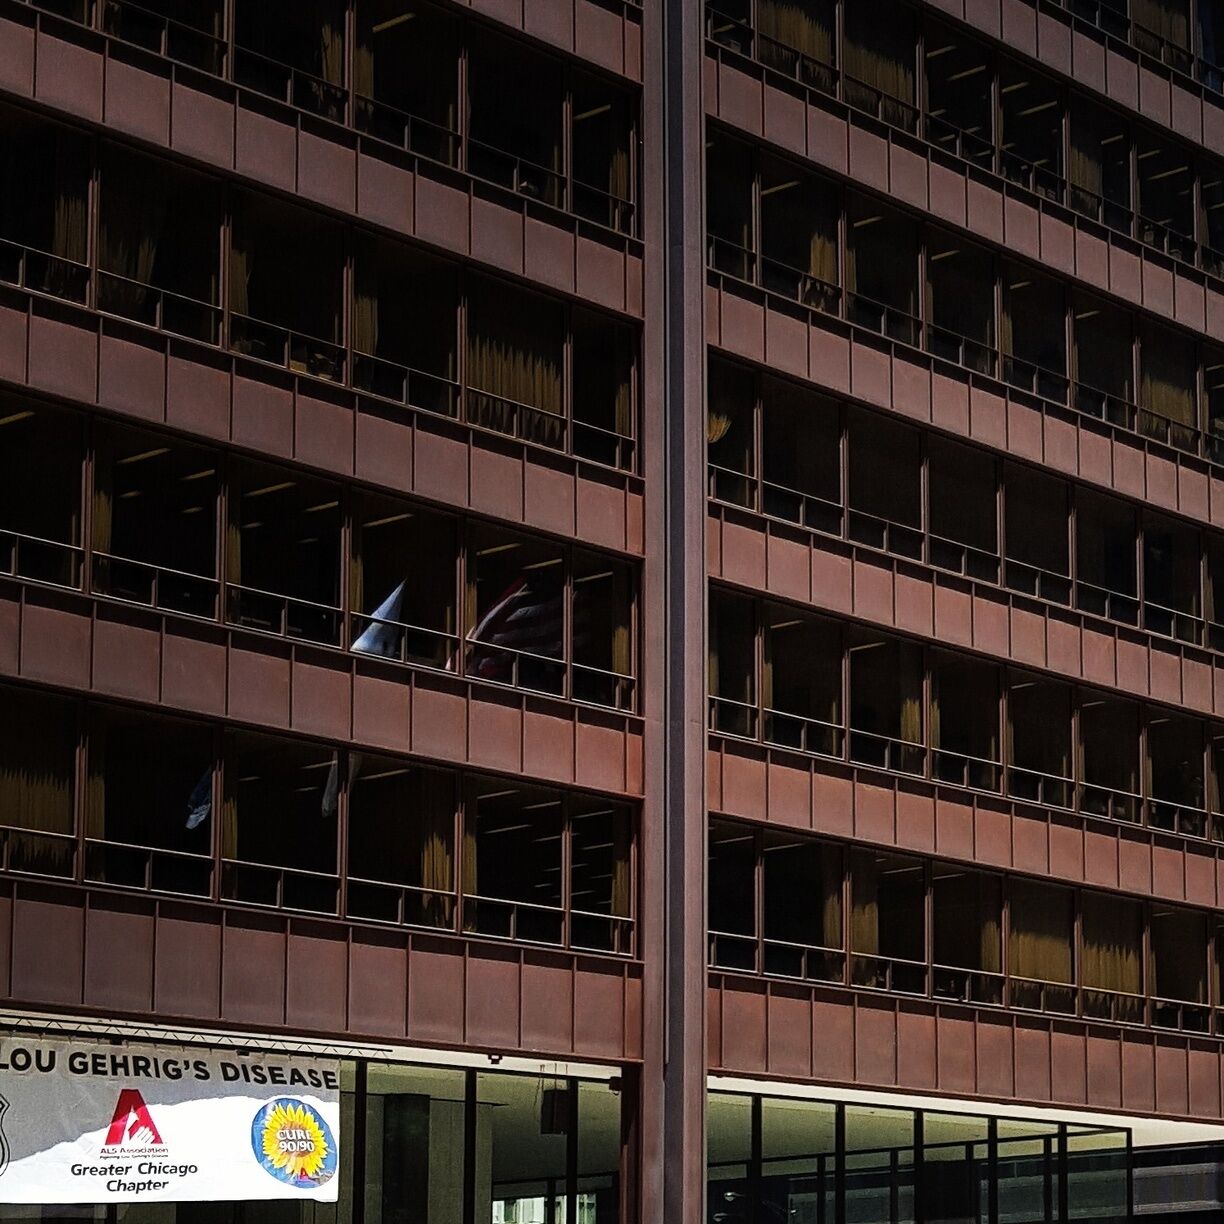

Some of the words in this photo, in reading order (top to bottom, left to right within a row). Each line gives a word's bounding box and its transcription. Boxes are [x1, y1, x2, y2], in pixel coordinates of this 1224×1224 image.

[68, 1051, 211, 1082] GEHRIG'S
[220, 1061, 339, 1090] DISEASE
[100, 1147, 118, 1155] ALS
[119, 1146, 169, 1154] Association
[279, 1140, 315, 1152] 90/90
[70, 1163, 132, 1177] Greater
[137, 1161, 198, 1177] Chicago
[106, 1179, 169, 1195] Chapter
